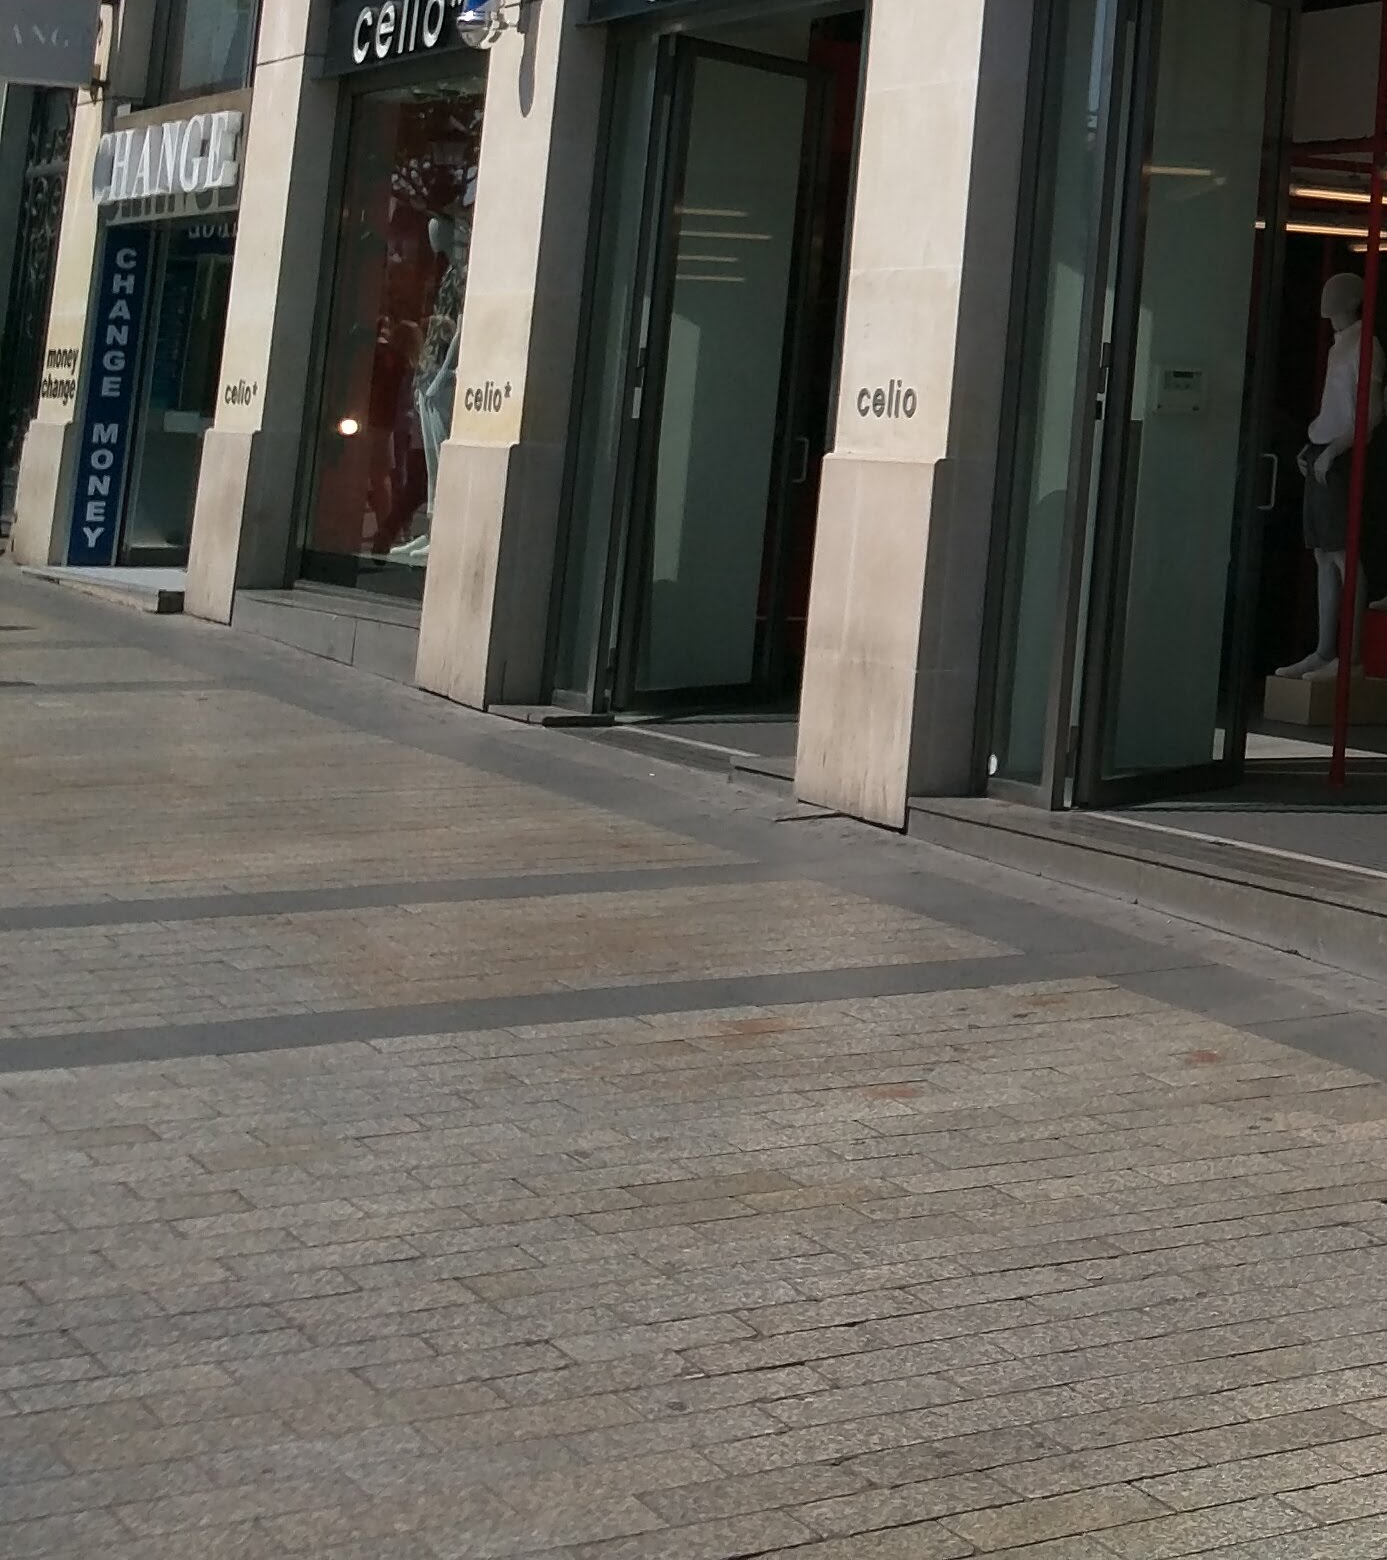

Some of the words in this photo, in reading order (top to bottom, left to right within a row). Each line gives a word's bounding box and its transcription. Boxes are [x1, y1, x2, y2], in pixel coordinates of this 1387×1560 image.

[93, 111, 240, 203] CHANGE
[101, 248, 137, 397] CHANGE
[42, 374, 75, 406] change
[47, 349, 79, 376] money
[857, 378, 917, 418] celio
[83, 422, 119, 548] MONEY
